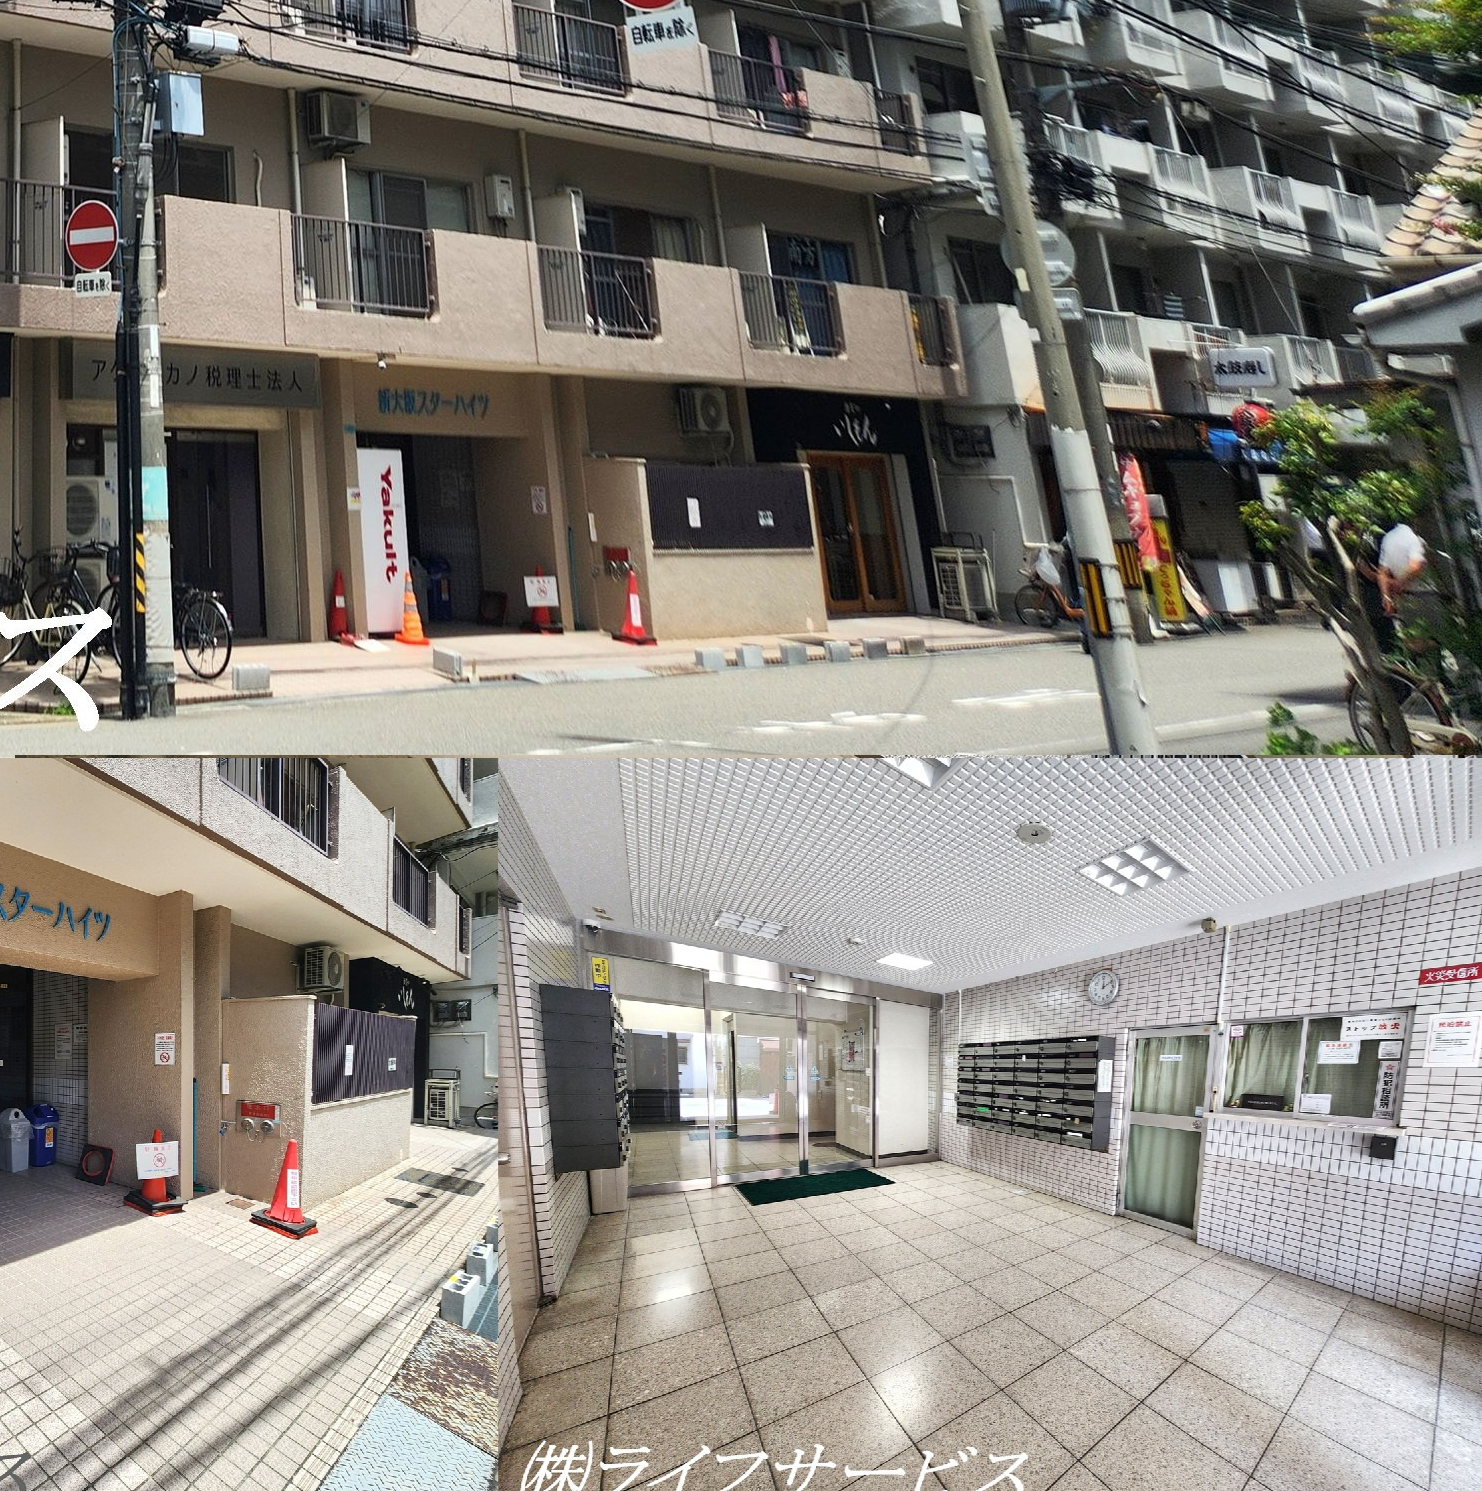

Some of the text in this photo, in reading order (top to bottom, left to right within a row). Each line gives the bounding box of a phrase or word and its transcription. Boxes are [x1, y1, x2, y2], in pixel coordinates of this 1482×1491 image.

[631, 17, 695, 45] 自転車を除く
[76, 279, 111, 295] 自転車を除く
[92, 359, 303, 393] アカノ税理士法人
[378, 388, 490, 418] 新大阪スターハイツ
[380, 465, 398, 584] Yakult
